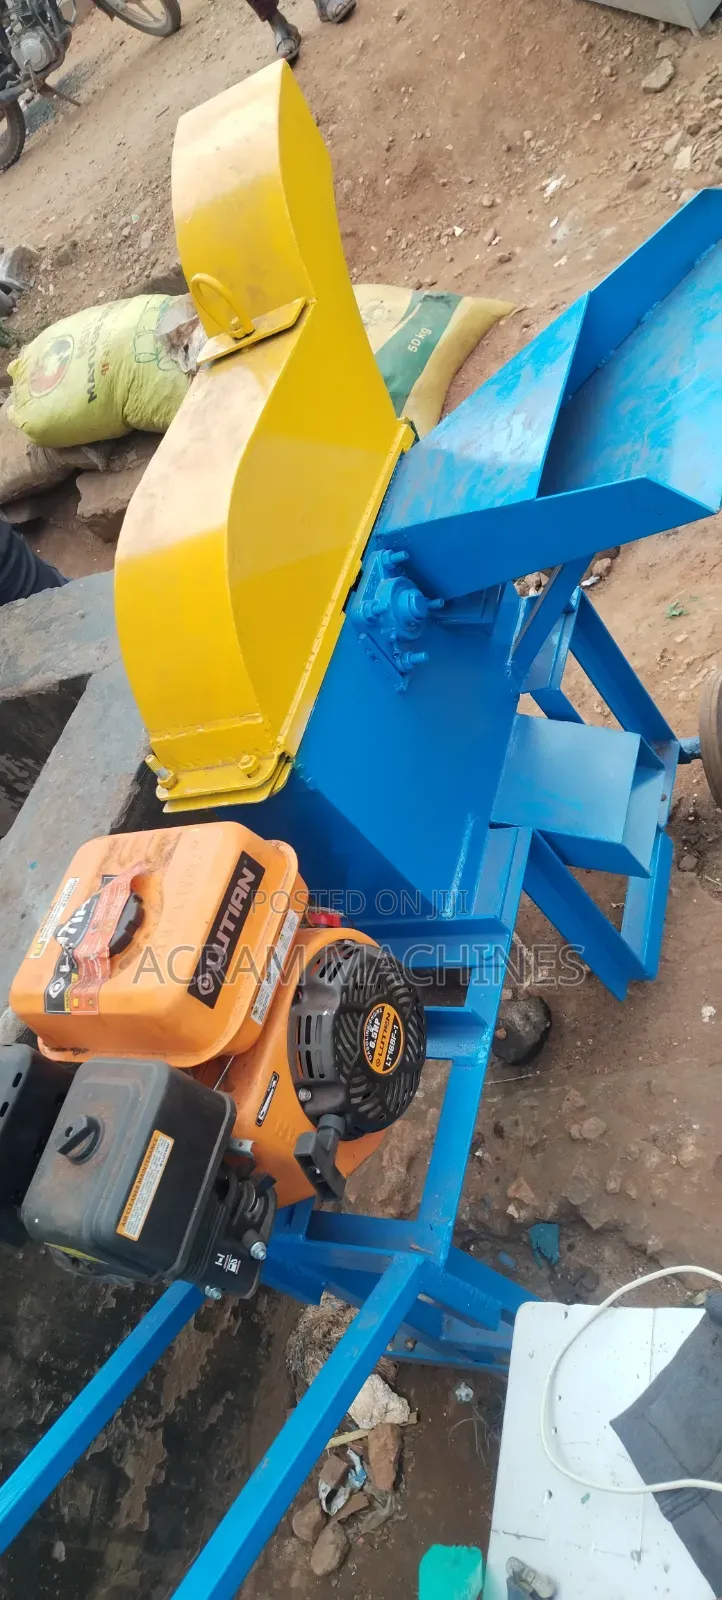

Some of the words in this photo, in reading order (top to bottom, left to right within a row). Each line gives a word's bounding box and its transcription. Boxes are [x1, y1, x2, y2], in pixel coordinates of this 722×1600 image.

[407, 338, 421, 353] 50
[416, 327, 432, 341] kg
[206, 867, 256, 971] LUTIAN
[121, 1214, 129, 1227] AIR
[138, 1139, 158, 1184] MAINTENANCE
